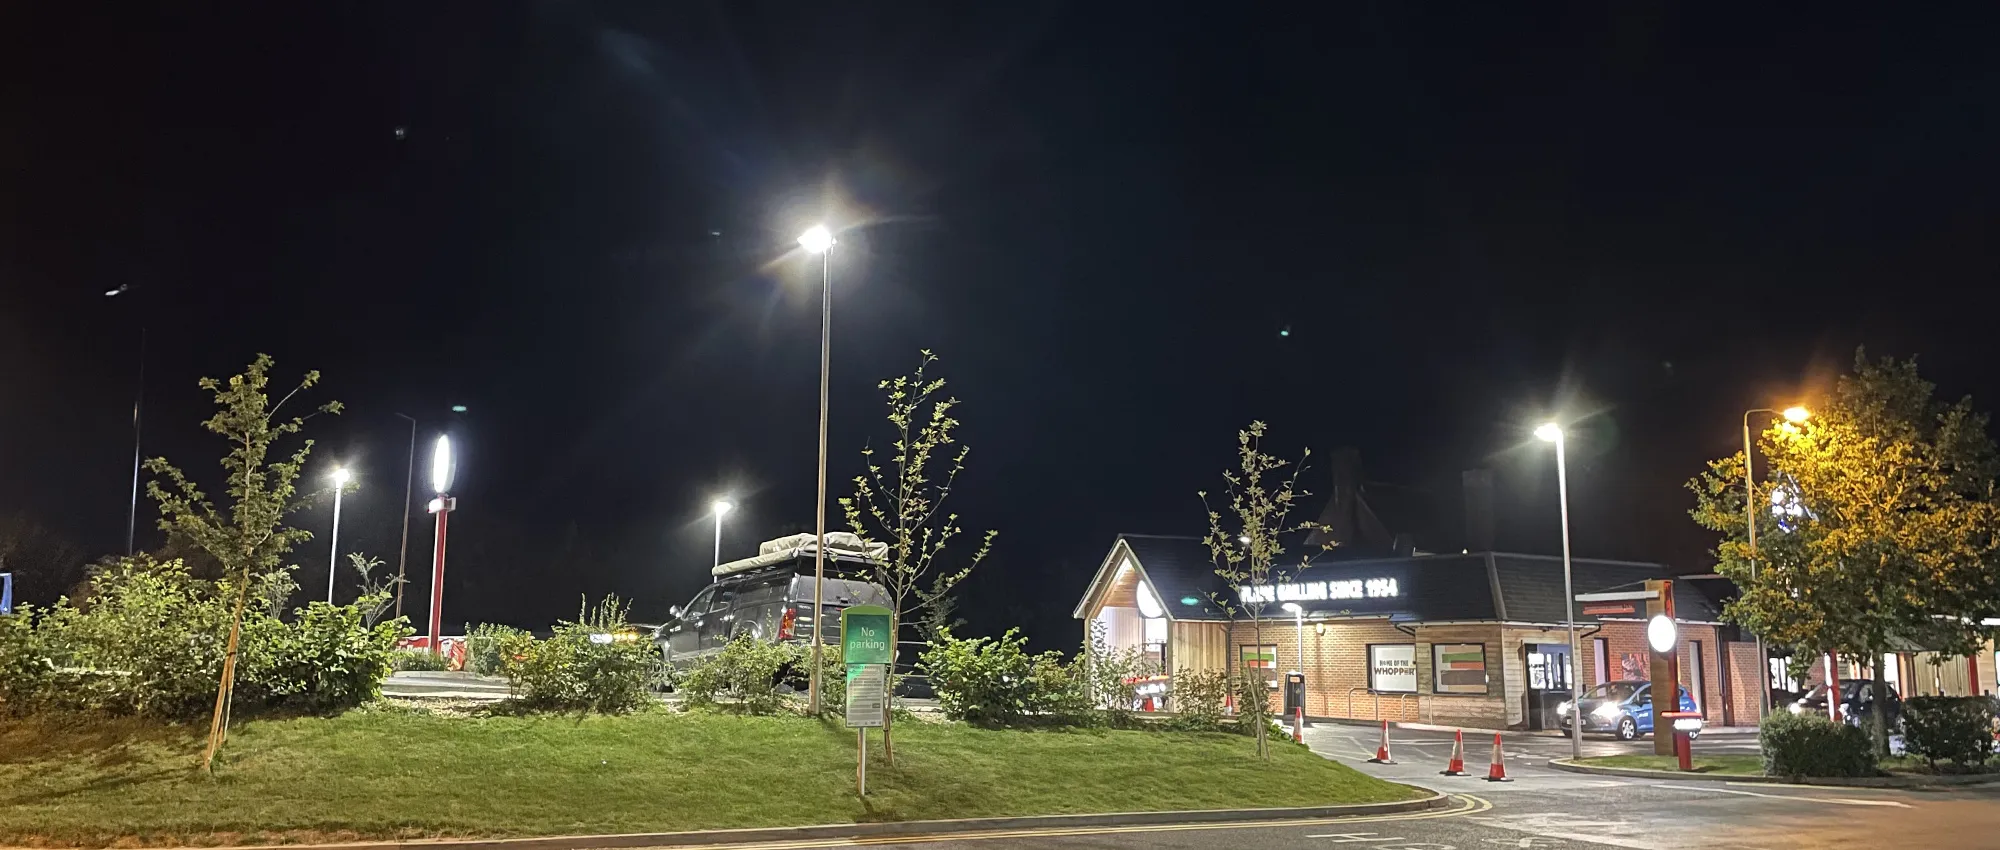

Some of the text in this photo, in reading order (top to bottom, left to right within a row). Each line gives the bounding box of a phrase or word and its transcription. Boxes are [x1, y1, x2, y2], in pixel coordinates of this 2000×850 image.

[1329, 580, 1363, 599] SINCE
[1366, 578, 1398, 597] 1954
[861, 627, 875, 637] No
[850, 639, 885, 651] parking
[1394, 659, 1400, 667] OF
[1400, 659, 1409, 667] THE
[1374, 667, 1415, 676] WHOPPER
